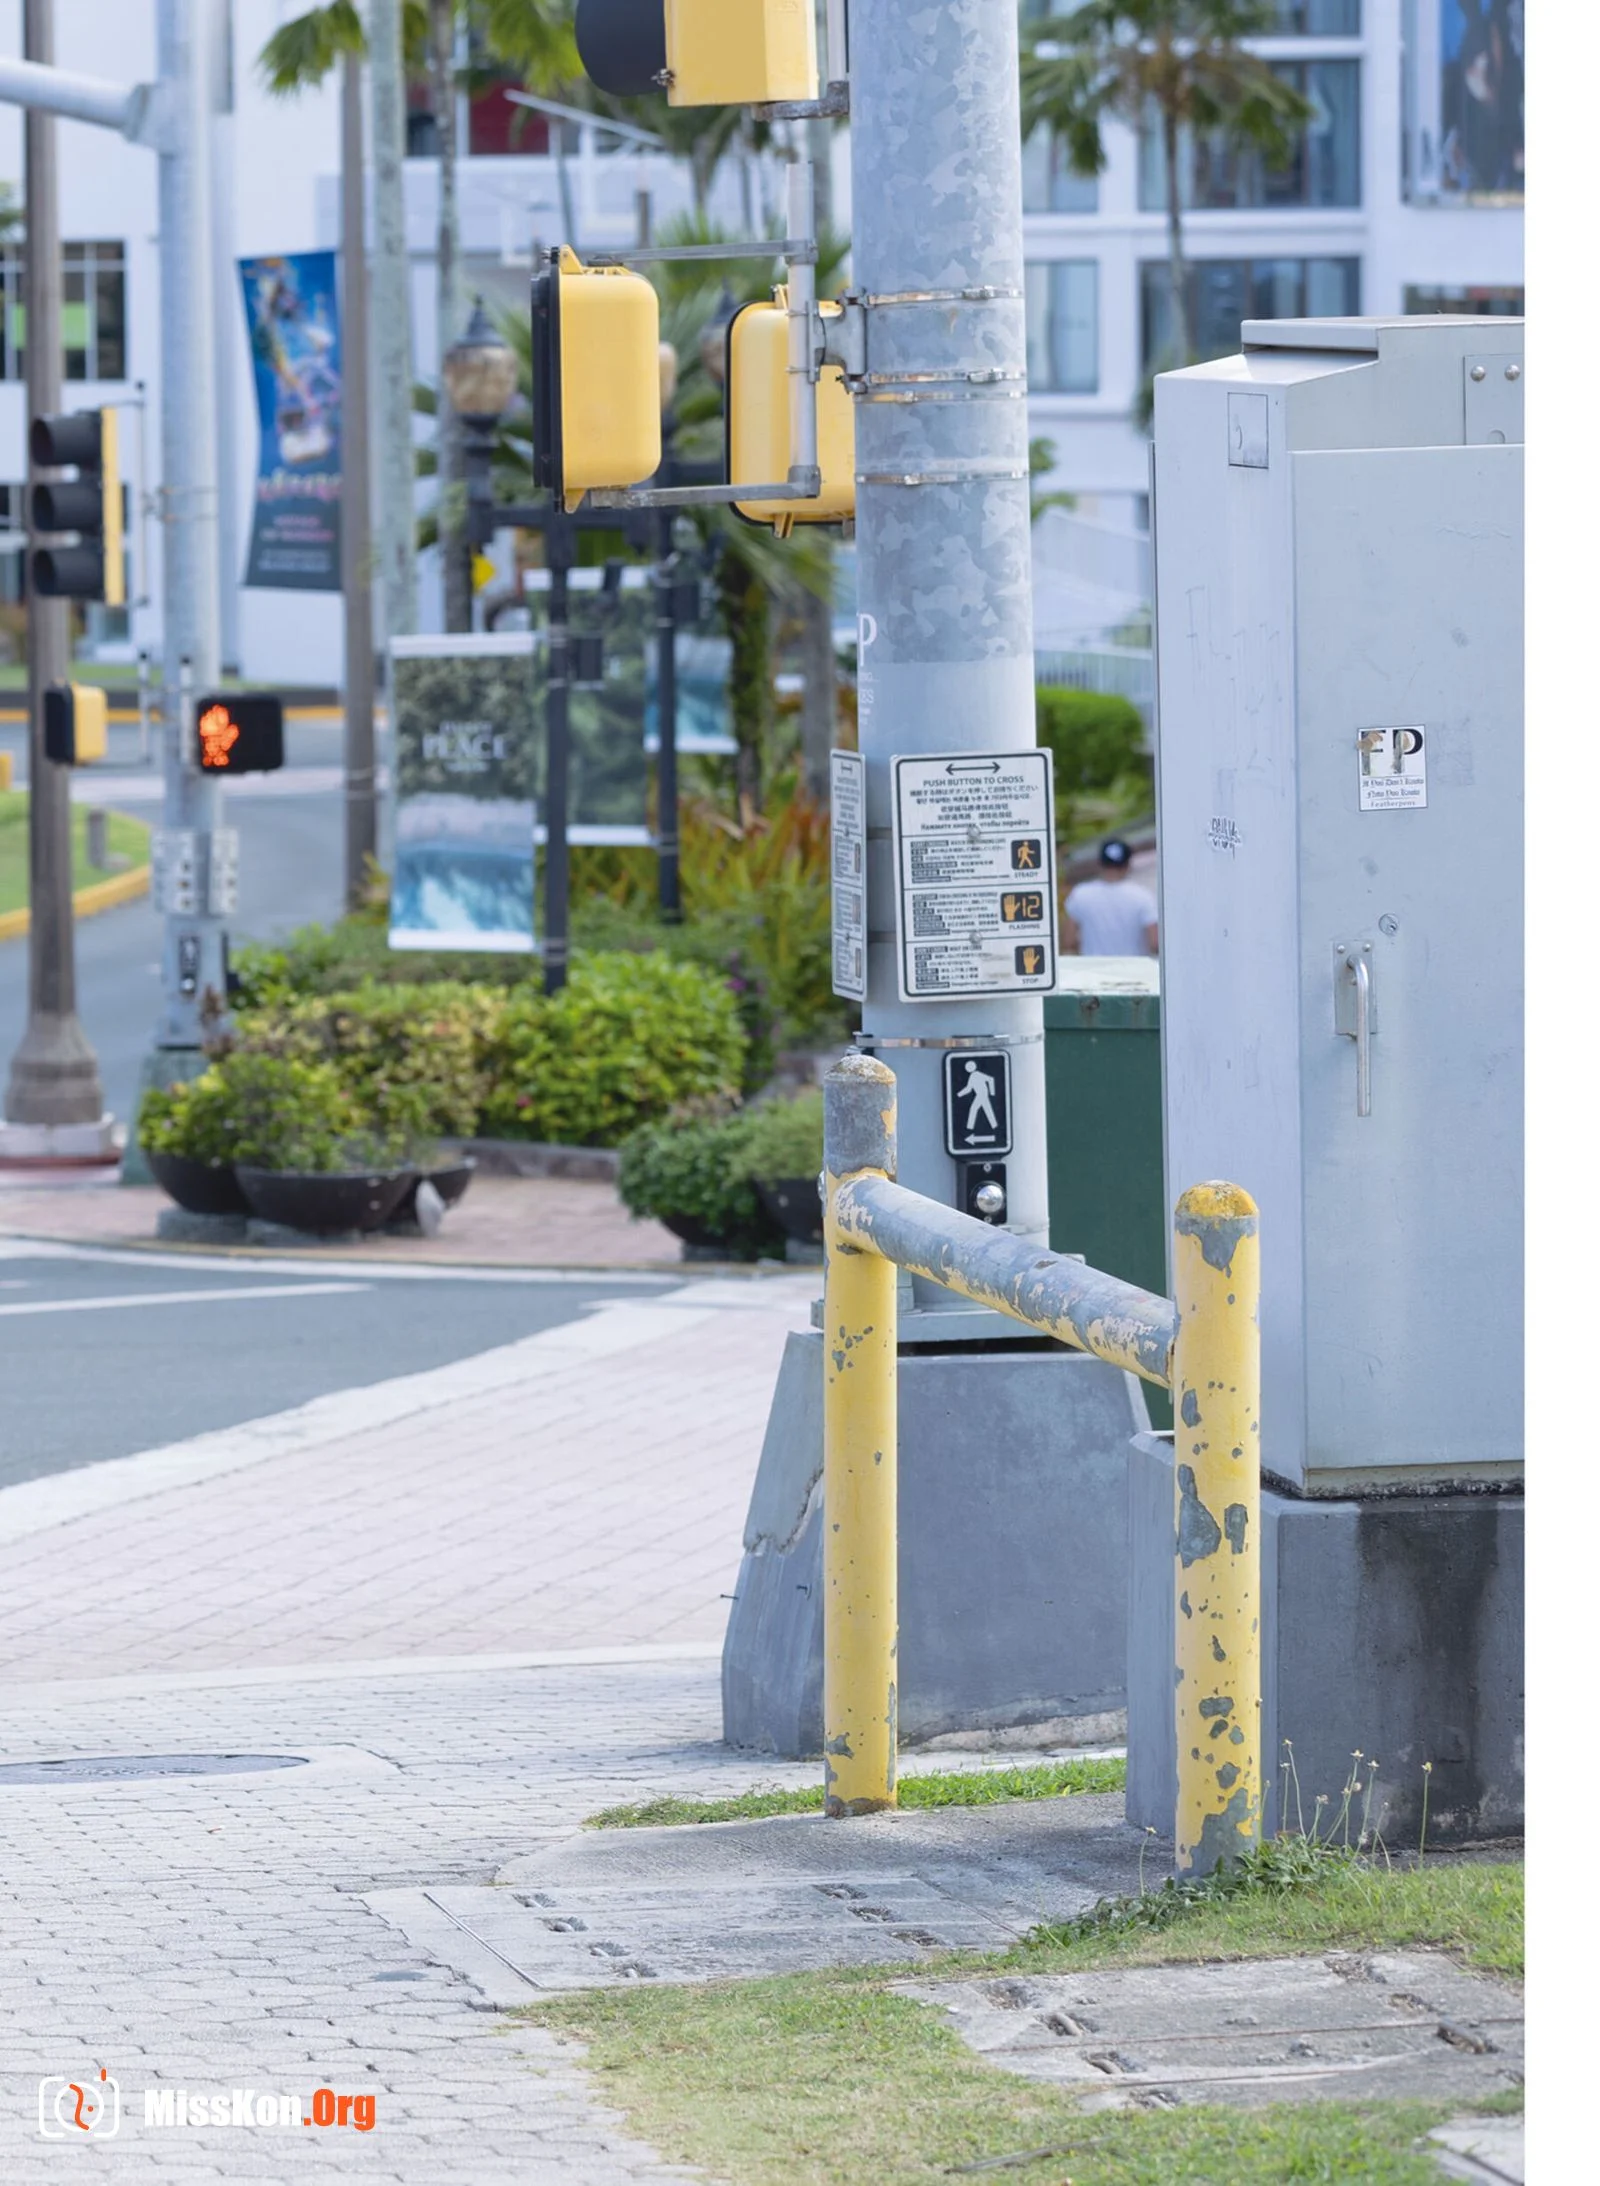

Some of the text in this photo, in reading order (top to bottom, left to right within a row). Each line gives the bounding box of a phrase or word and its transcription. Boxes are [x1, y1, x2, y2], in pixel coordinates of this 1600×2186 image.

[923, 775, 1024, 788] PUSH BUTTON TO CROSS
